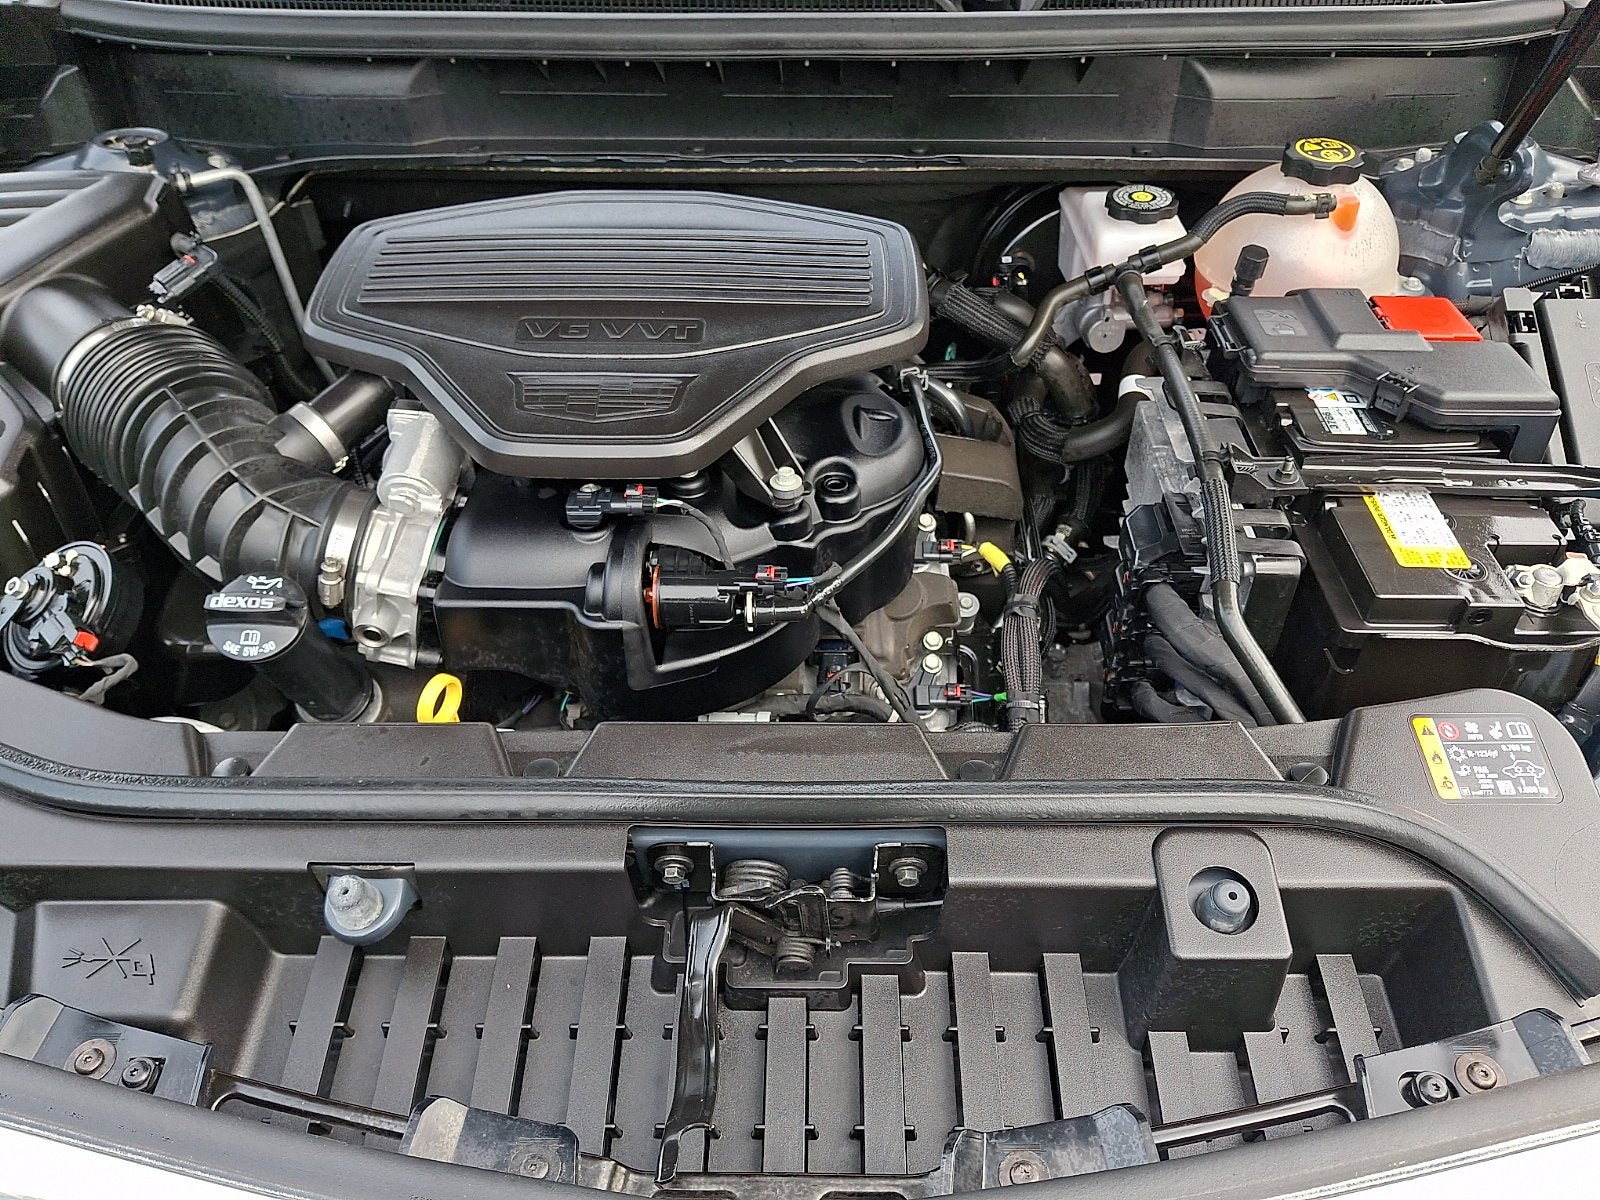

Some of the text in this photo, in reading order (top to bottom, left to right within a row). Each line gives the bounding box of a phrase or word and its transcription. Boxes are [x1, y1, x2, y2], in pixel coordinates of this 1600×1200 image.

[525, 321, 698, 340] V6 VVT
[209, 593, 274, 609] dexos
[222, 640, 277, 657] SAE 5W-30
